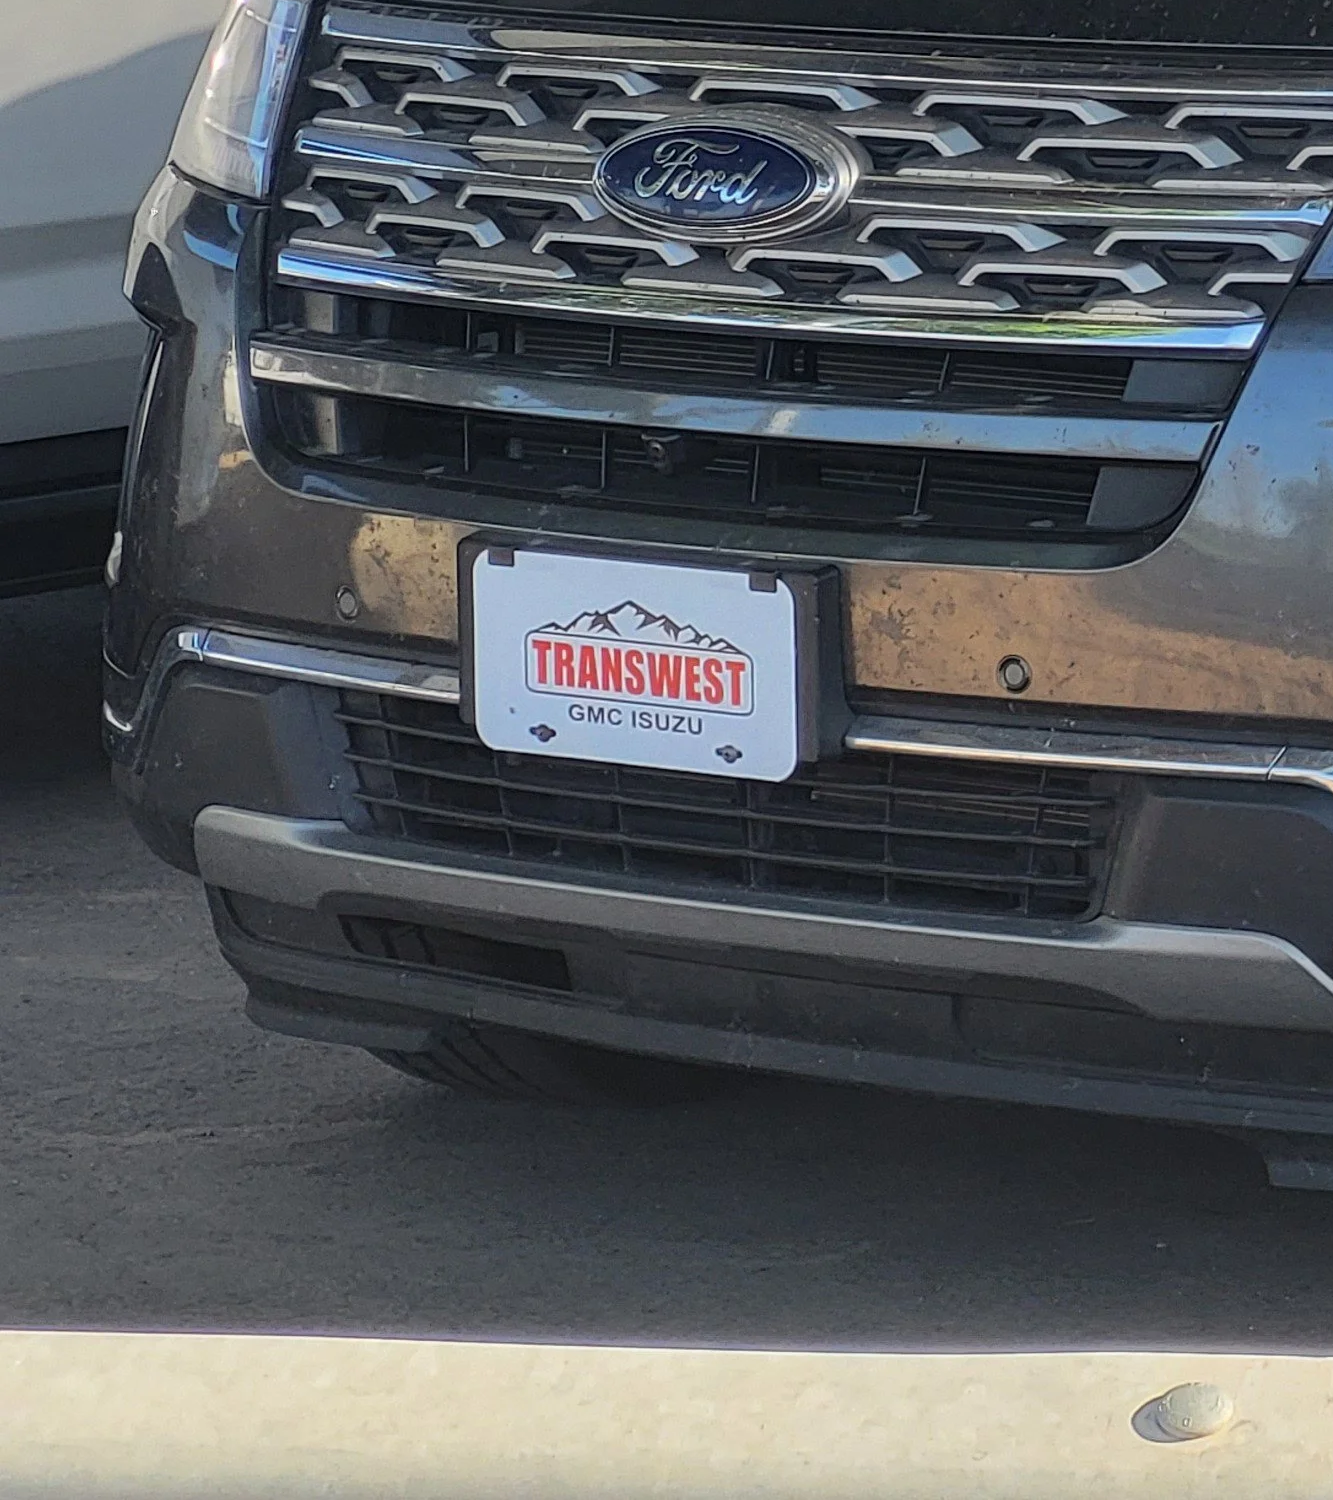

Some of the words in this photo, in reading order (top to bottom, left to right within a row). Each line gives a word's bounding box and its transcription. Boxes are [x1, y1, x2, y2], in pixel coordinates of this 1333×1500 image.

[634, 137, 768, 205] Ford
[531, 639, 746, 707] TRANSWEST
[568, 703, 623, 725] GMC
[631, 709, 703, 736] ISUZU
